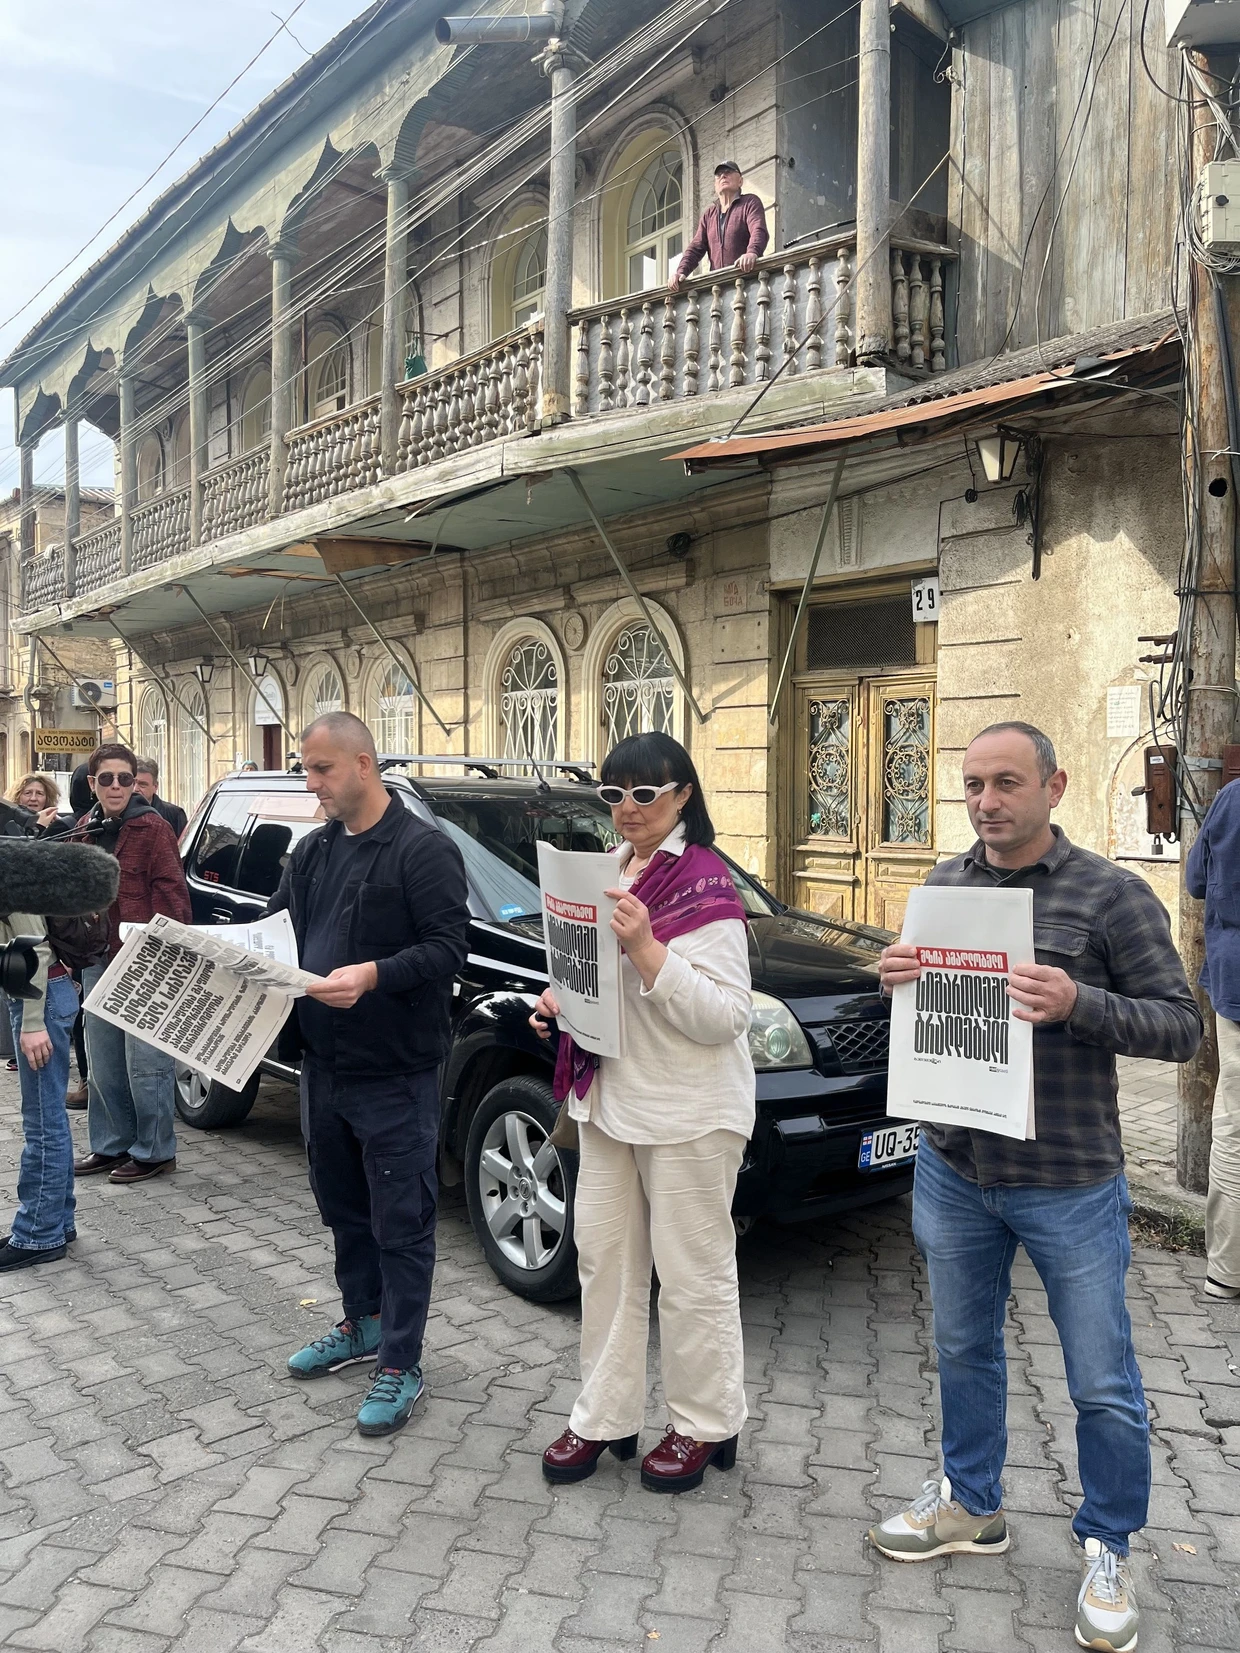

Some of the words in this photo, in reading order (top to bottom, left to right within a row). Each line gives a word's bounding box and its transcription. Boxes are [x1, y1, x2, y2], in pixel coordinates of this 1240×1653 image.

[915, 588, 935, 611] 29
[37, 735, 94, 747] ადვოკატი
[102, 934, 163, 1014] ნაციონალები
[920, 949, 943, 965] მზია
[945, 951, 1004, 969] ამაღლობელი
[136, 1000, 168, 1030] ფულს
[158, 994, 196, 1043] ხელისუფლება
[169, 989, 213, 1048] პარტნიორებთან
[915, 971, 1010, 1021] სიმართლეში
[178, 995, 224, 1053] თანამშრომლობს
[914, 1012, 1009, 1065] ბრალდებული
[860, 1151, 871, 1163] GE
